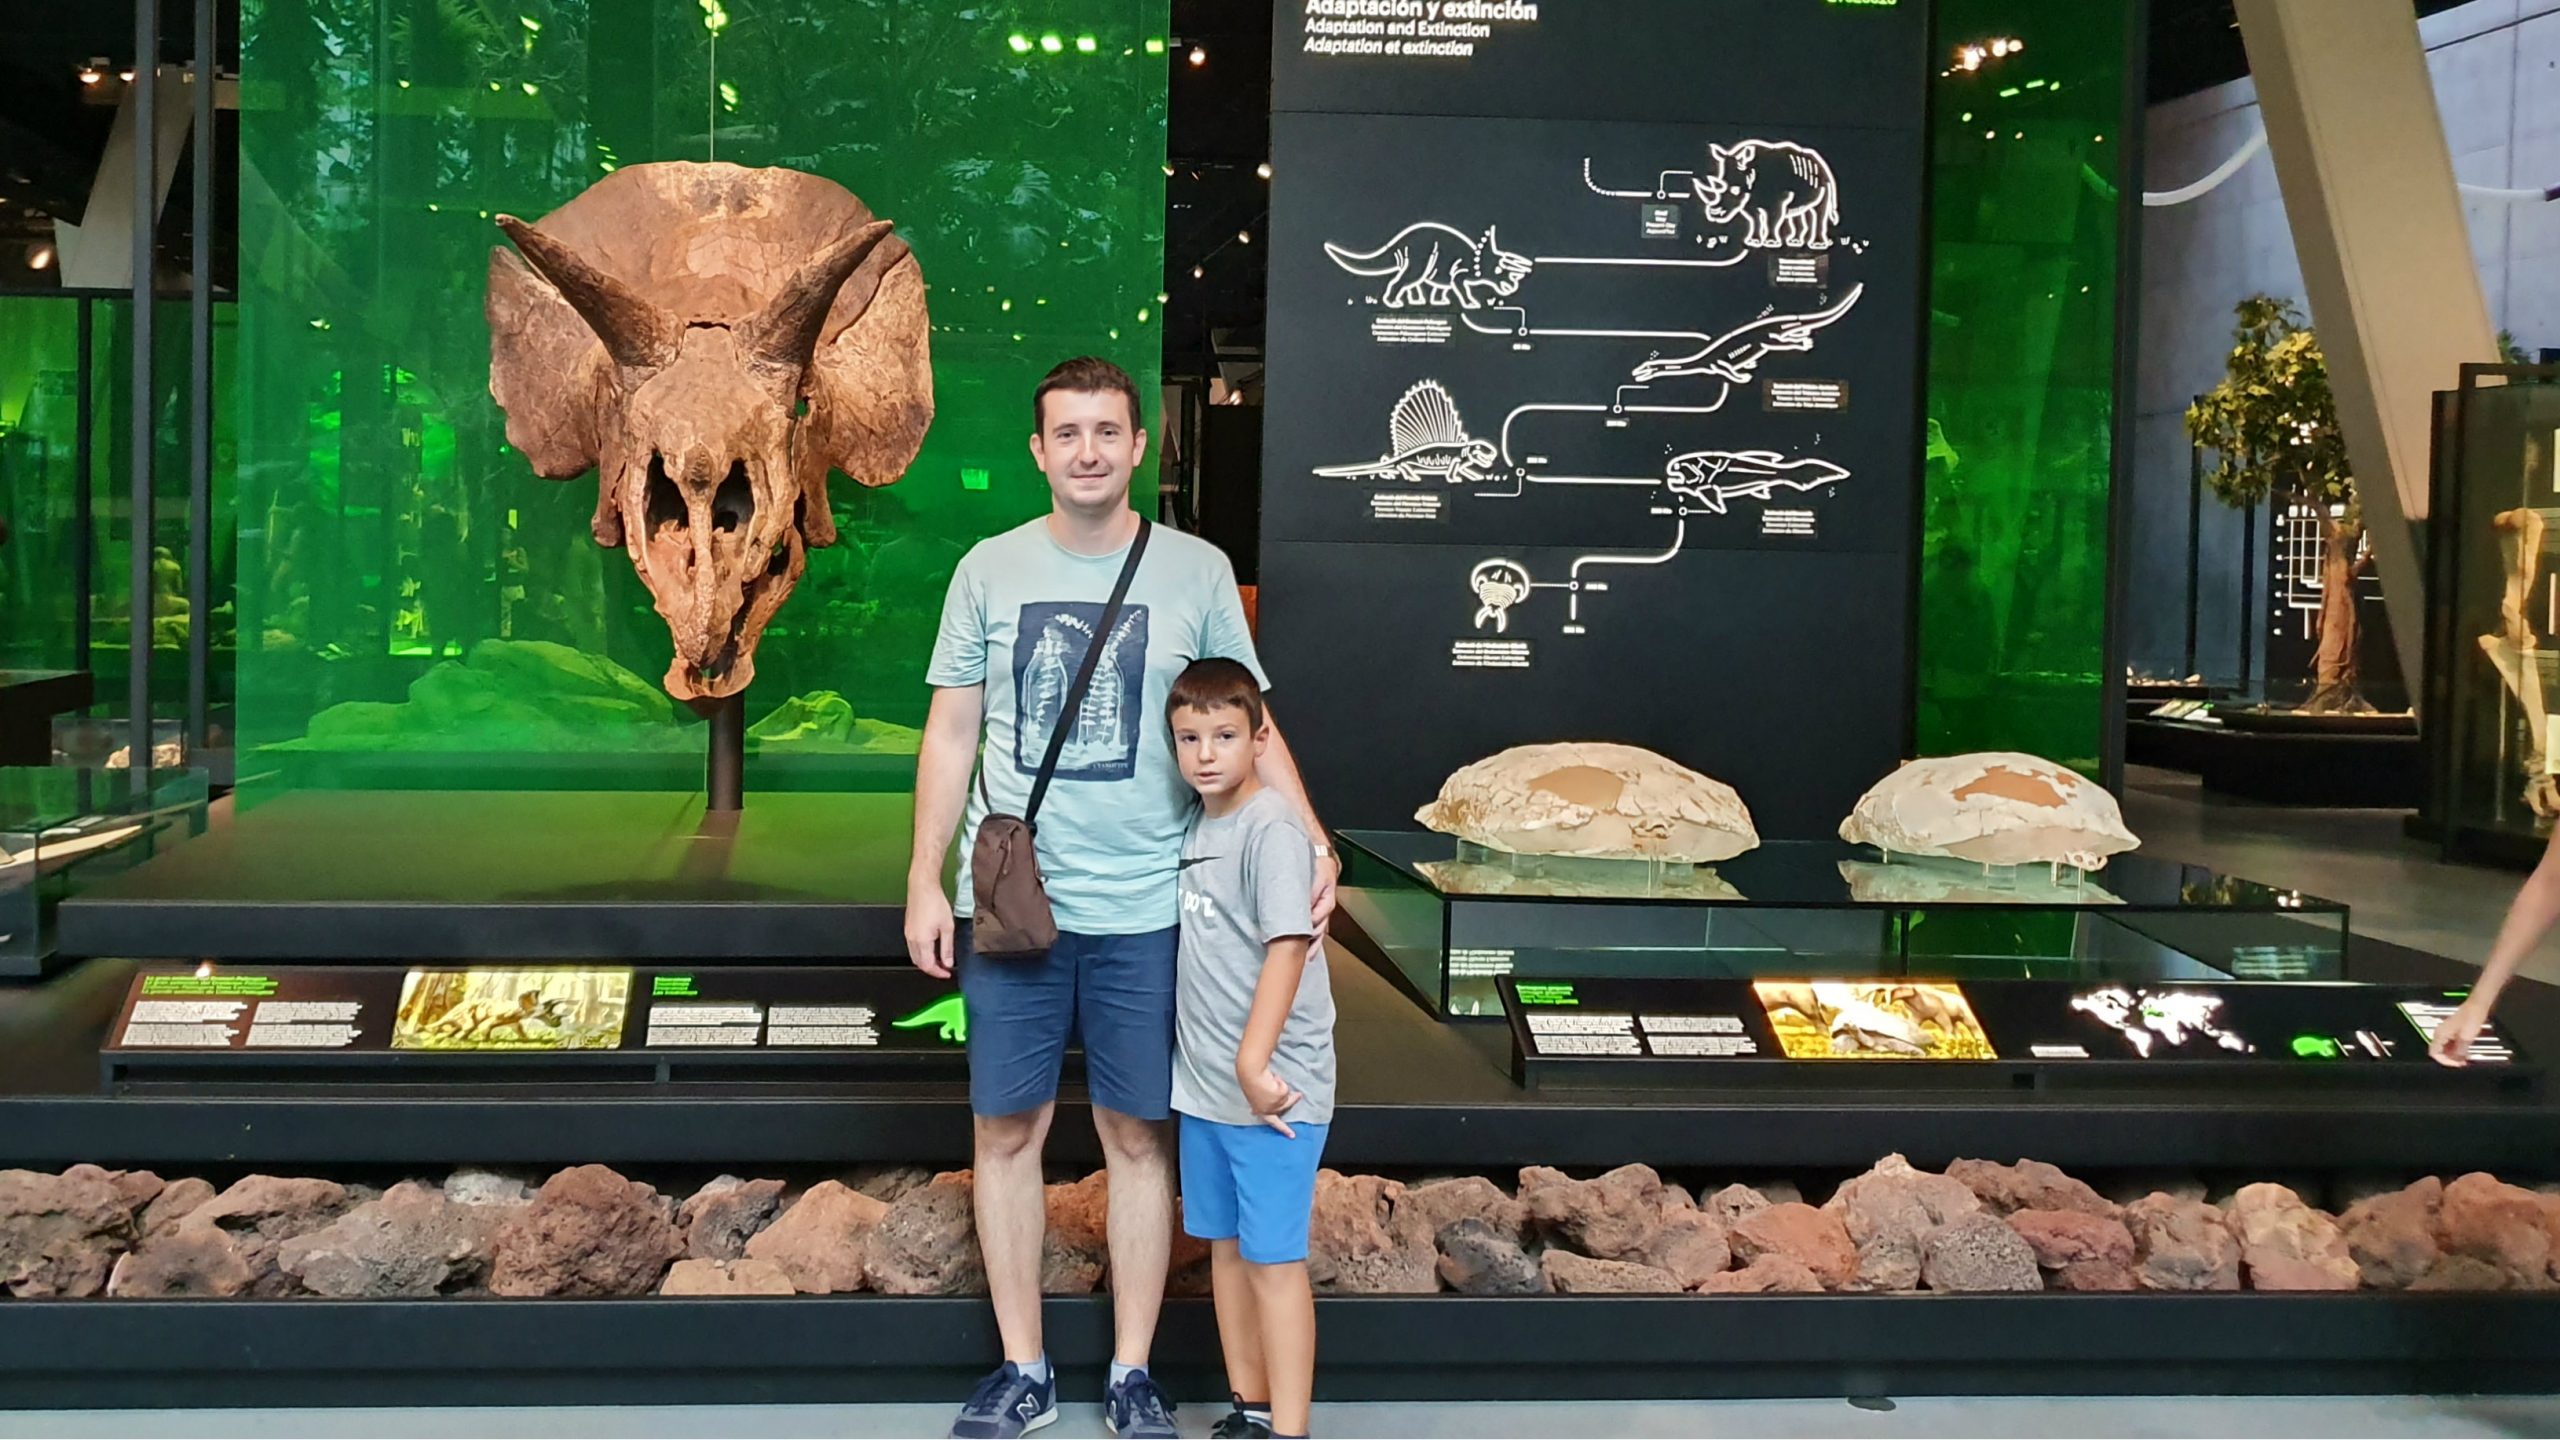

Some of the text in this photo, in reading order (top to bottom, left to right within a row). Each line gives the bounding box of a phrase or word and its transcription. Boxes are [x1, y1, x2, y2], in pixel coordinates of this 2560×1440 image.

[1426, 0, 1441, 20] y
[1442, 0, 1538, 20] extinción
[1304, 17, 1491, 38] Adaptation and Extinction
[1303, 36, 1475, 57] Adaptation et extinction
